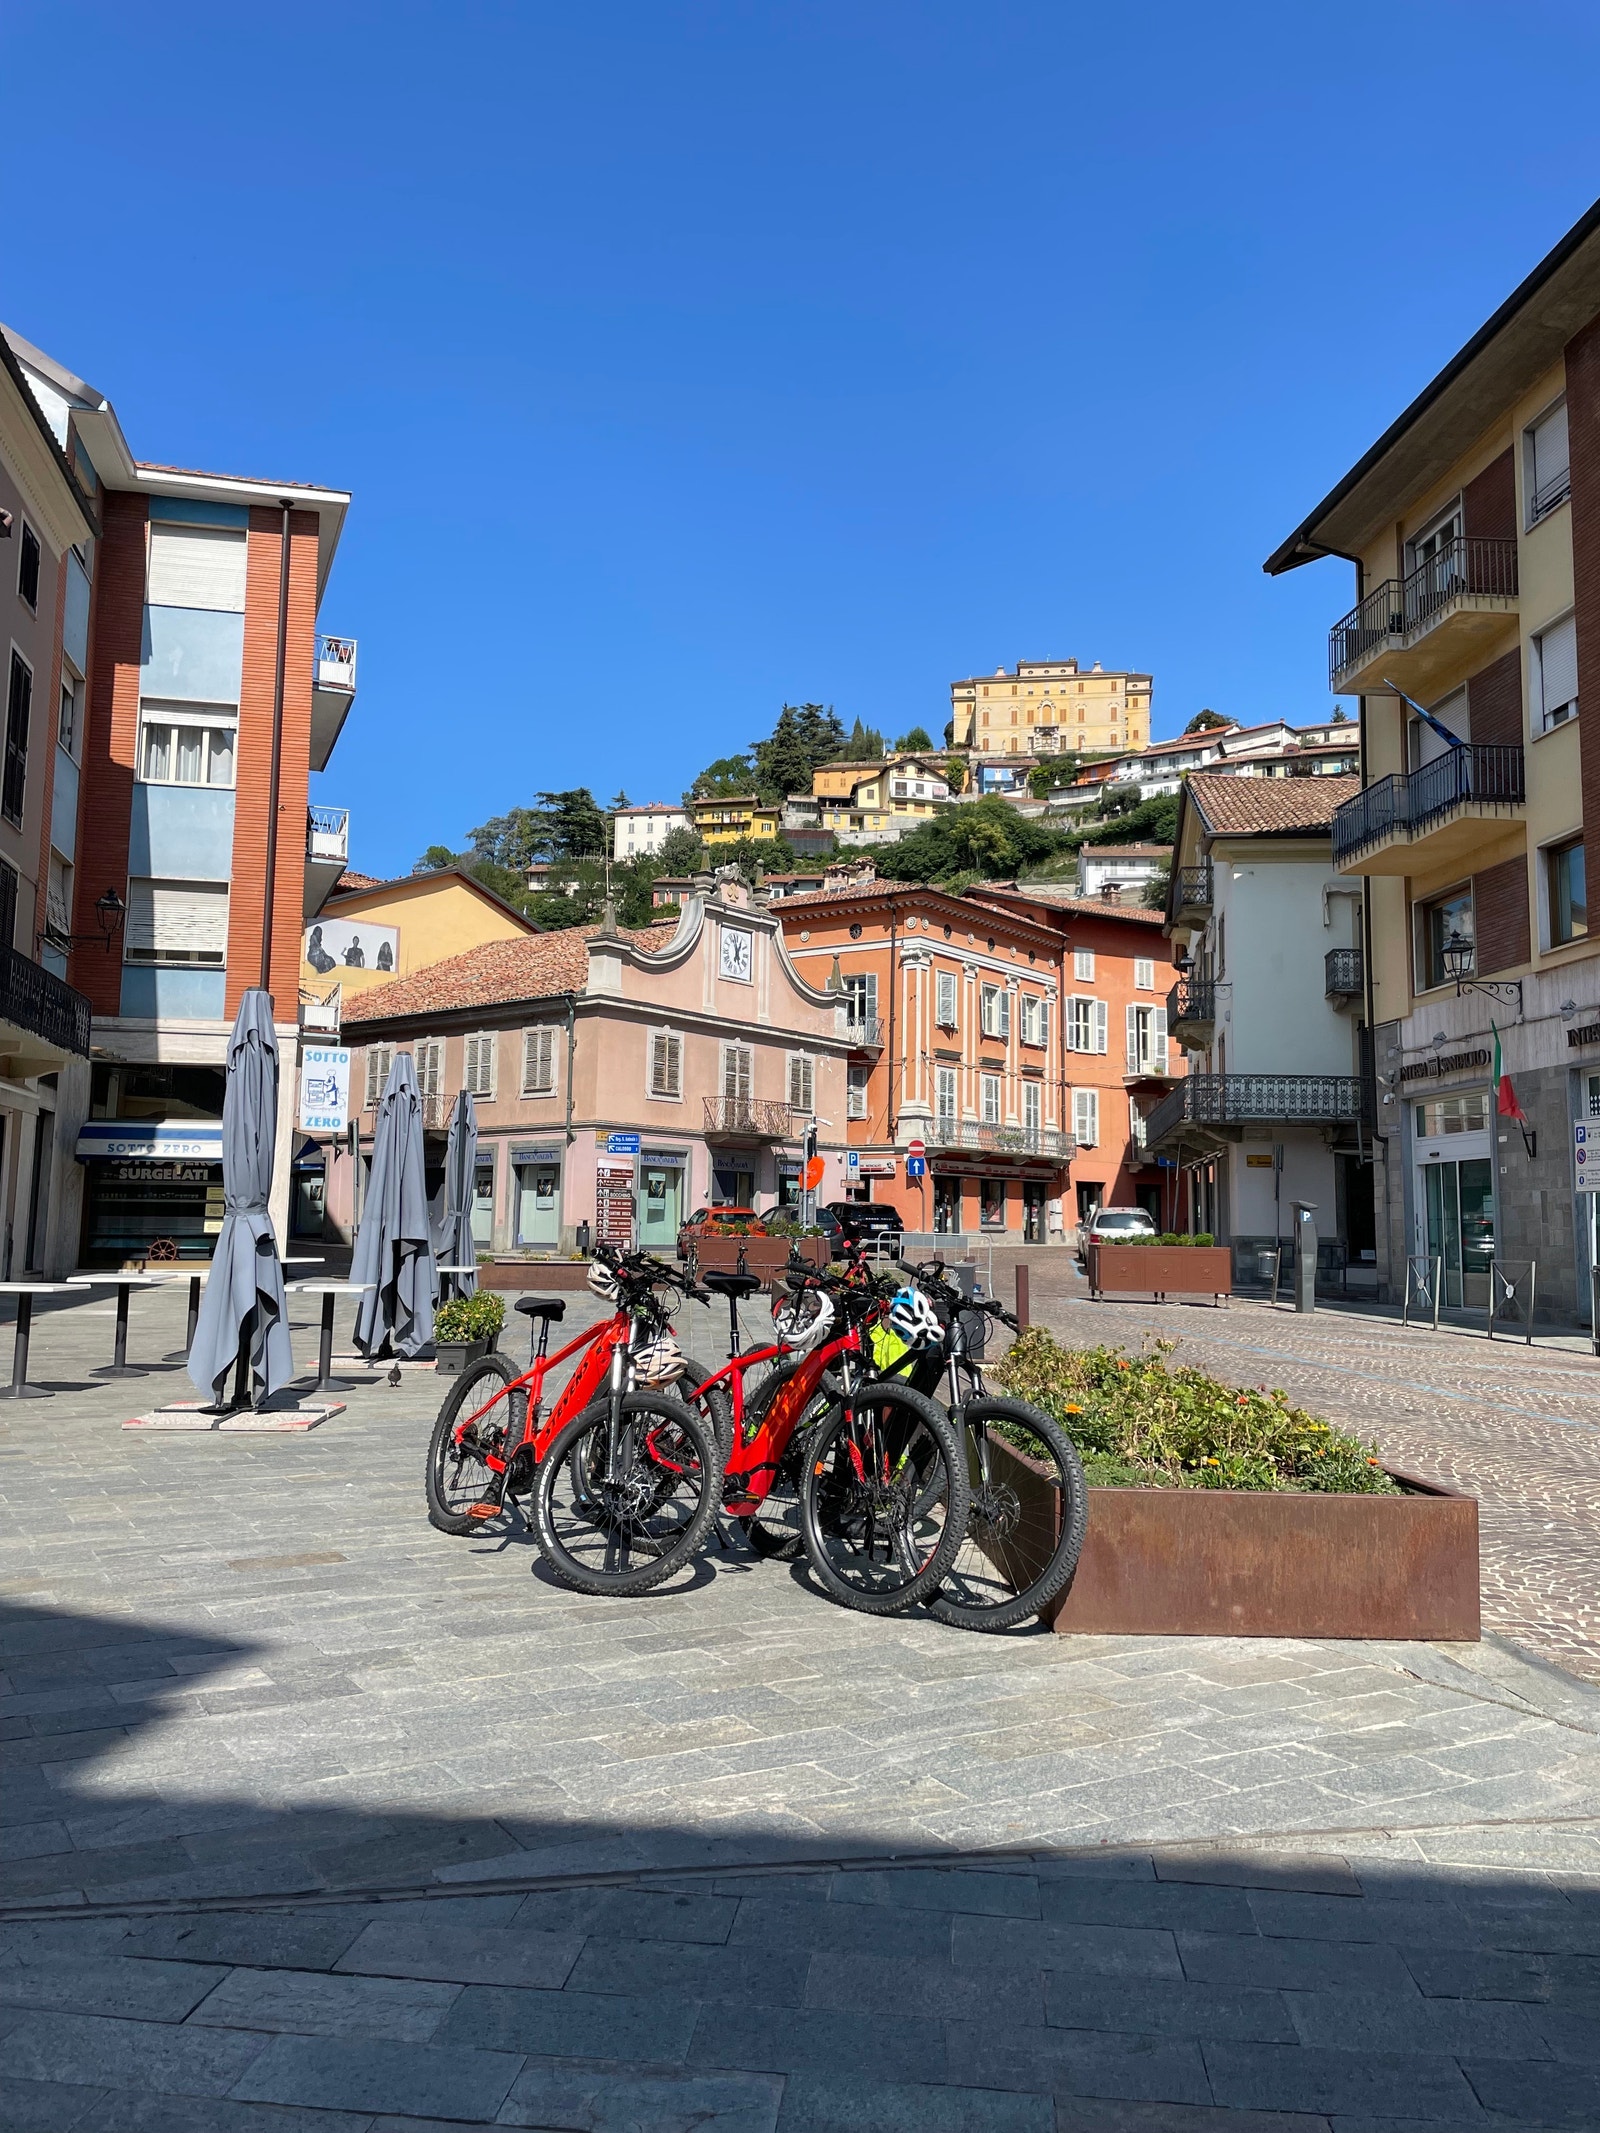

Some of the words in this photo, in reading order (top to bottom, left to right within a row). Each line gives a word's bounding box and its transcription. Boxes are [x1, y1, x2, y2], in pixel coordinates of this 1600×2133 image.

[305, 1051, 348, 1064] SOTTO
[305, 1116, 341, 1128] ZERO
[107, 1144, 156, 1154] SOTTO
[163, 1144, 202, 1154] ZERO
[119, 1168, 209, 1181] SURGELATI
[545, 1361, 588, 1440] STEVENS
